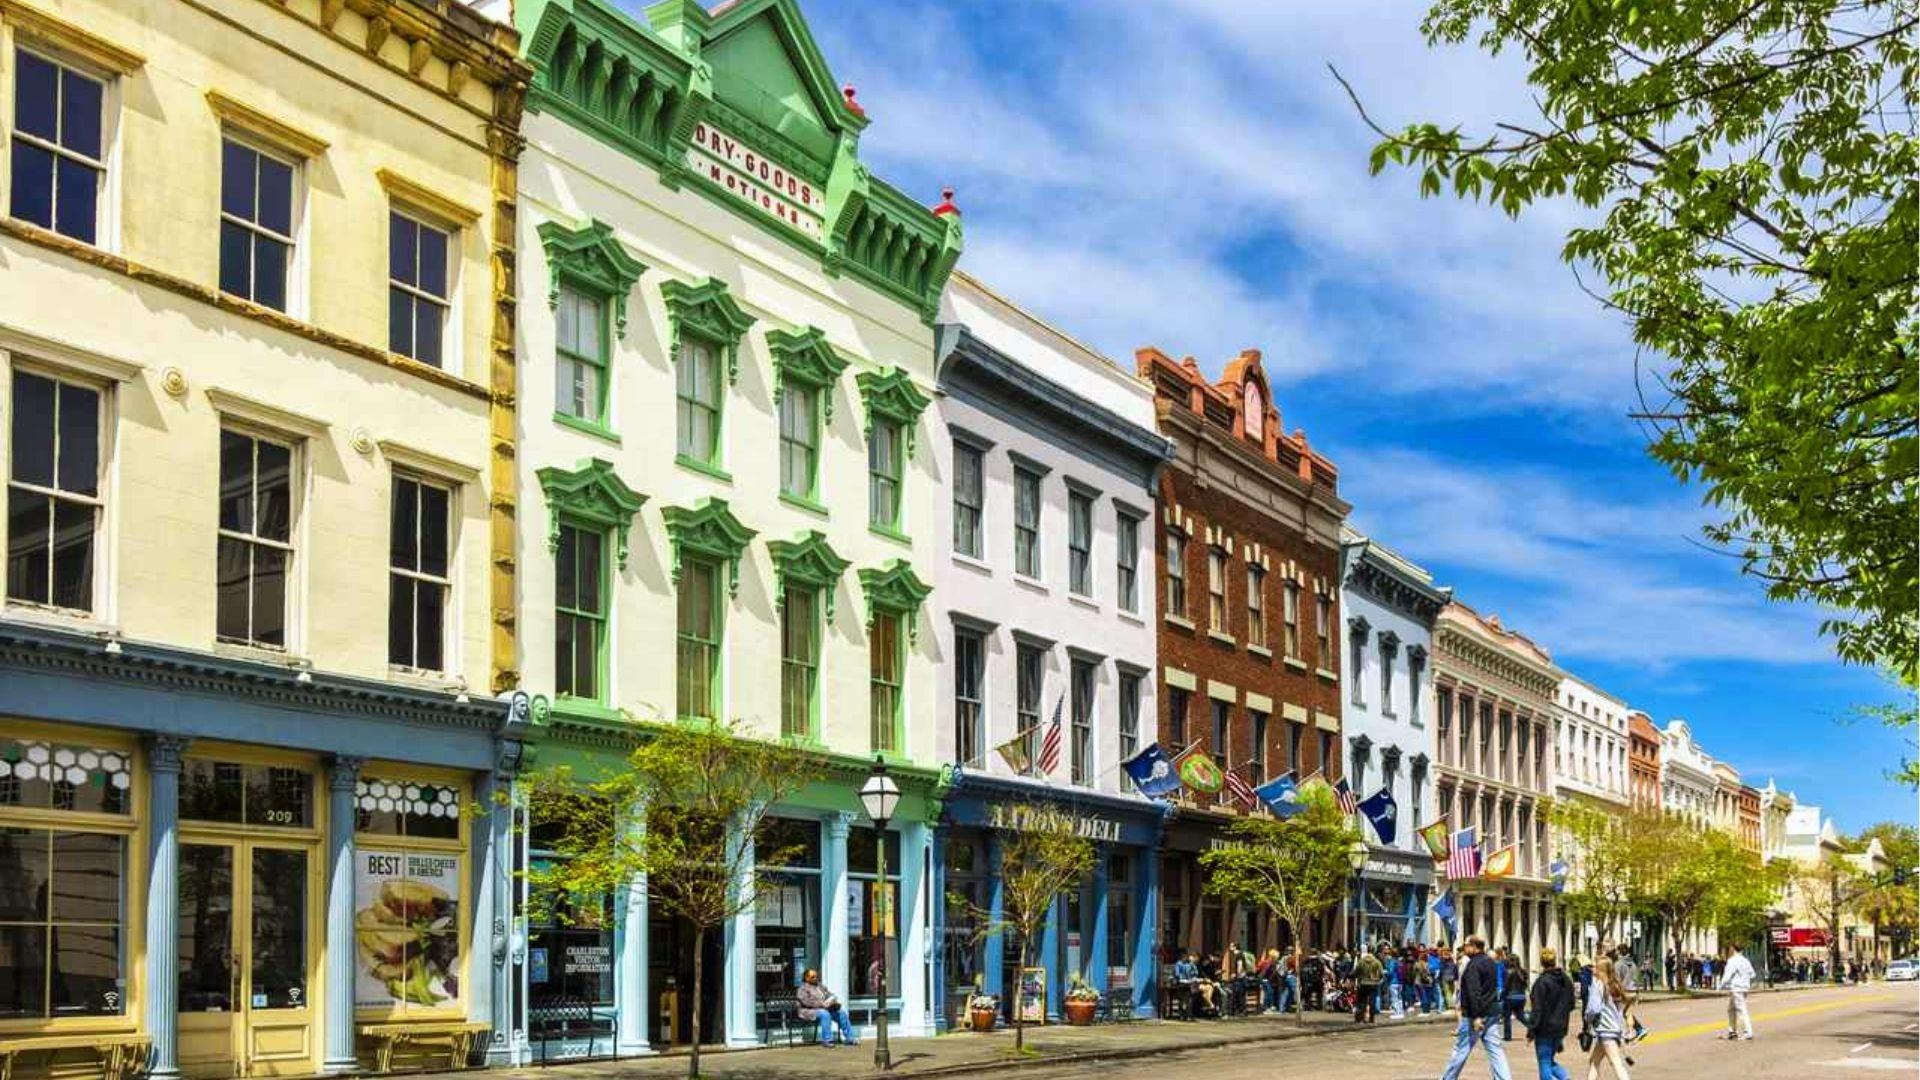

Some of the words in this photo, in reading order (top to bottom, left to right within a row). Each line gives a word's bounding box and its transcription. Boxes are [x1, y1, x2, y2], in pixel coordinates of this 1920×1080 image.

[696, 124, 735, 159] DRY
[746, 153, 811, 204] GOODS
[710, 165, 798, 224] NOTIONS
[266, 809, 293, 823] 209
[368, 855, 401, 875] BEST
[566, 946, 610, 955] CHARLESTON
[565, 964, 611, 972] INFORMATION
